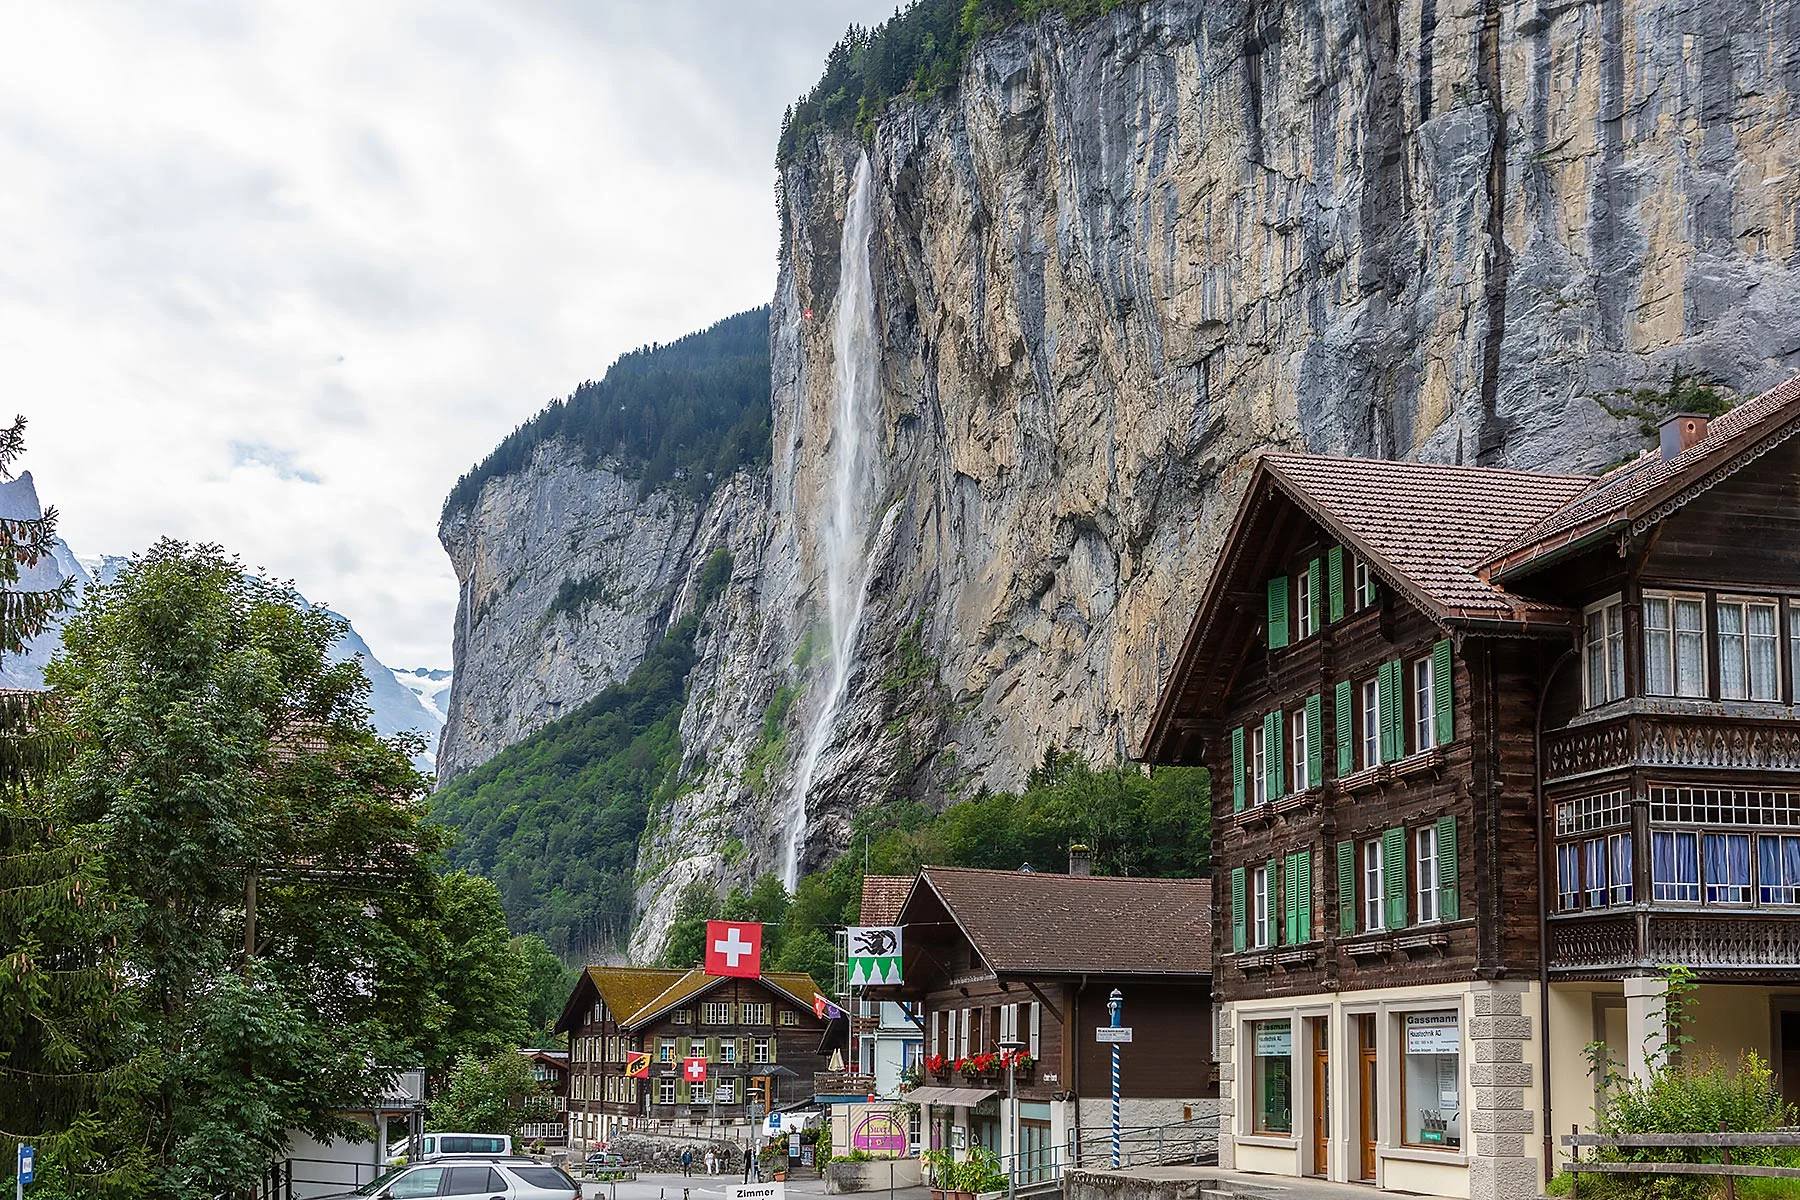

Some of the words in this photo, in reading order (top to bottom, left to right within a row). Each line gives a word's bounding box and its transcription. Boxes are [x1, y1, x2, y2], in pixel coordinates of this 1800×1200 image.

[1407, 1016, 1457, 1024] Gassmann
[772, 1113, 779, 1122] P
[736, 1190, 774, 1198] Zimmer
